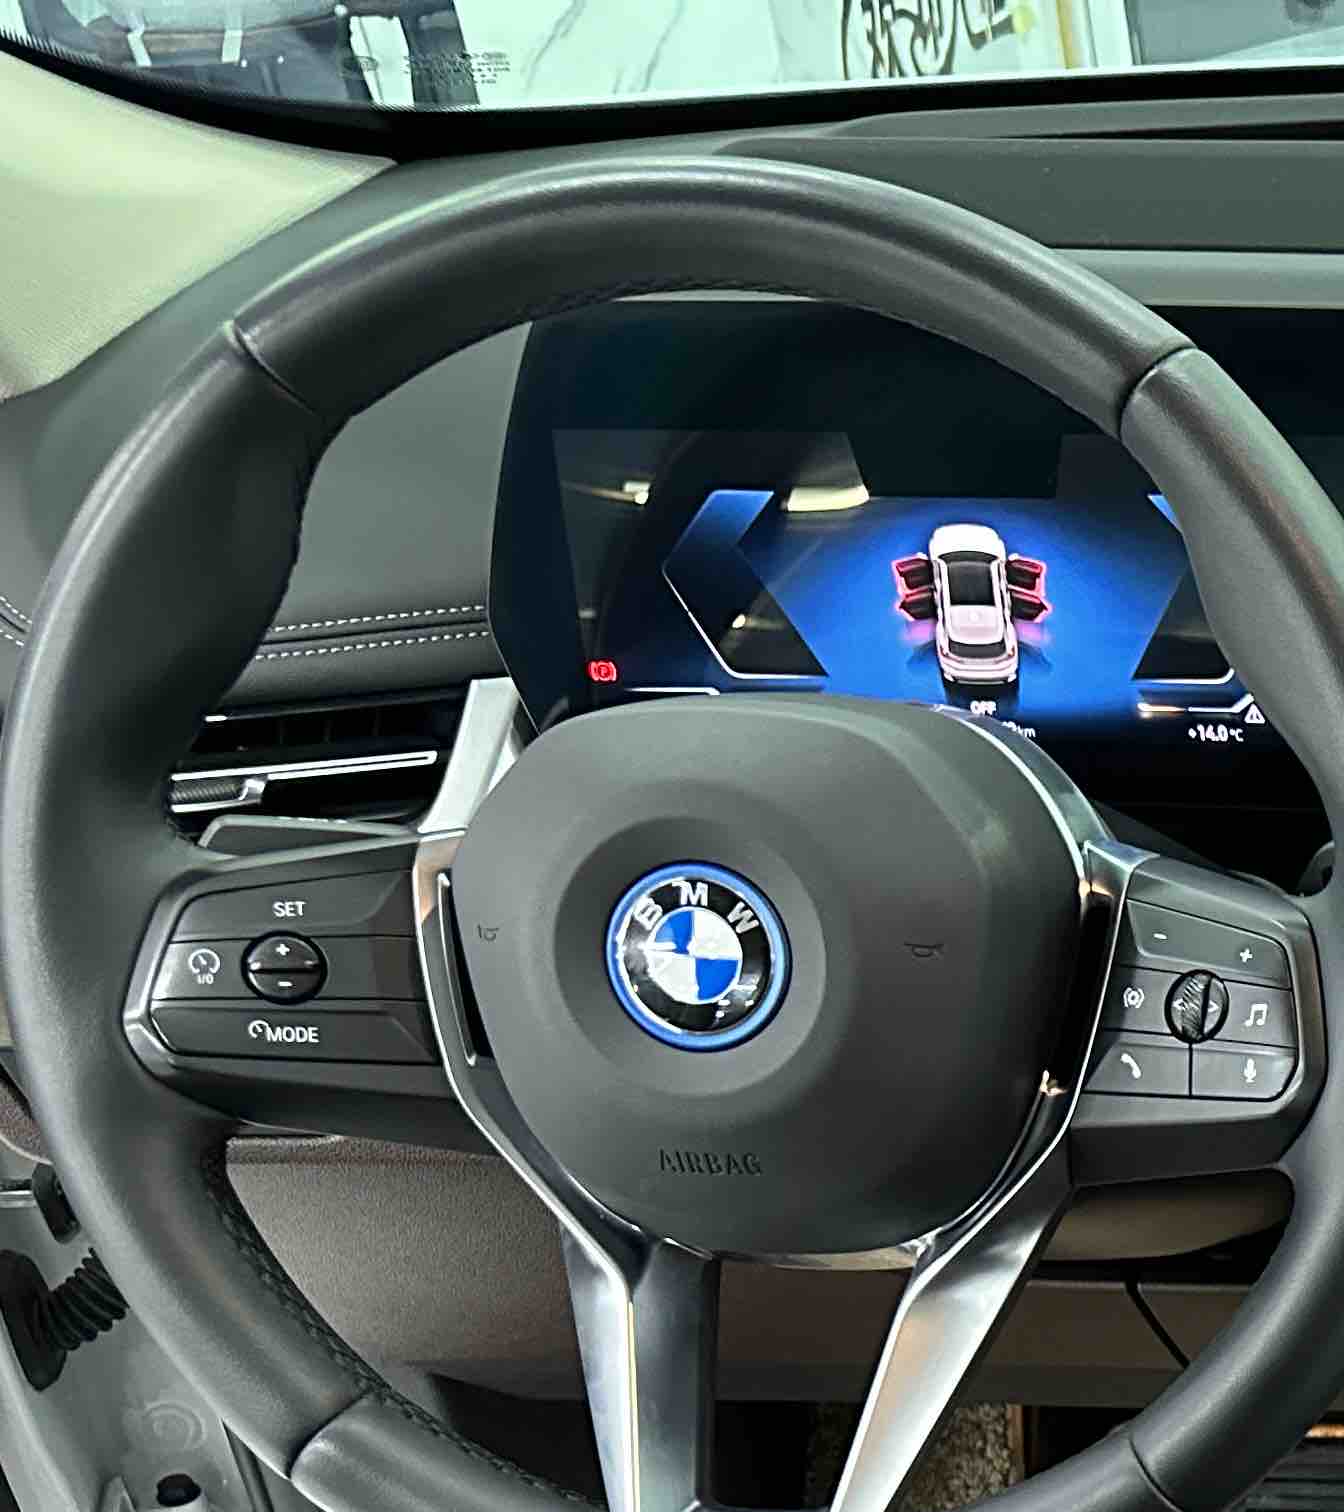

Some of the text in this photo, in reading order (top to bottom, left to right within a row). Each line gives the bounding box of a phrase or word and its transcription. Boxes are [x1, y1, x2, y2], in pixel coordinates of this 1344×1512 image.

[970, 700, 996, 716] OFF
[272, 901, 306, 917] SET
[632, 881, 760, 934] BMW
[266, 1026, 320, 1043] MODE
[659, 1148, 764, 1176] AIRBAG
